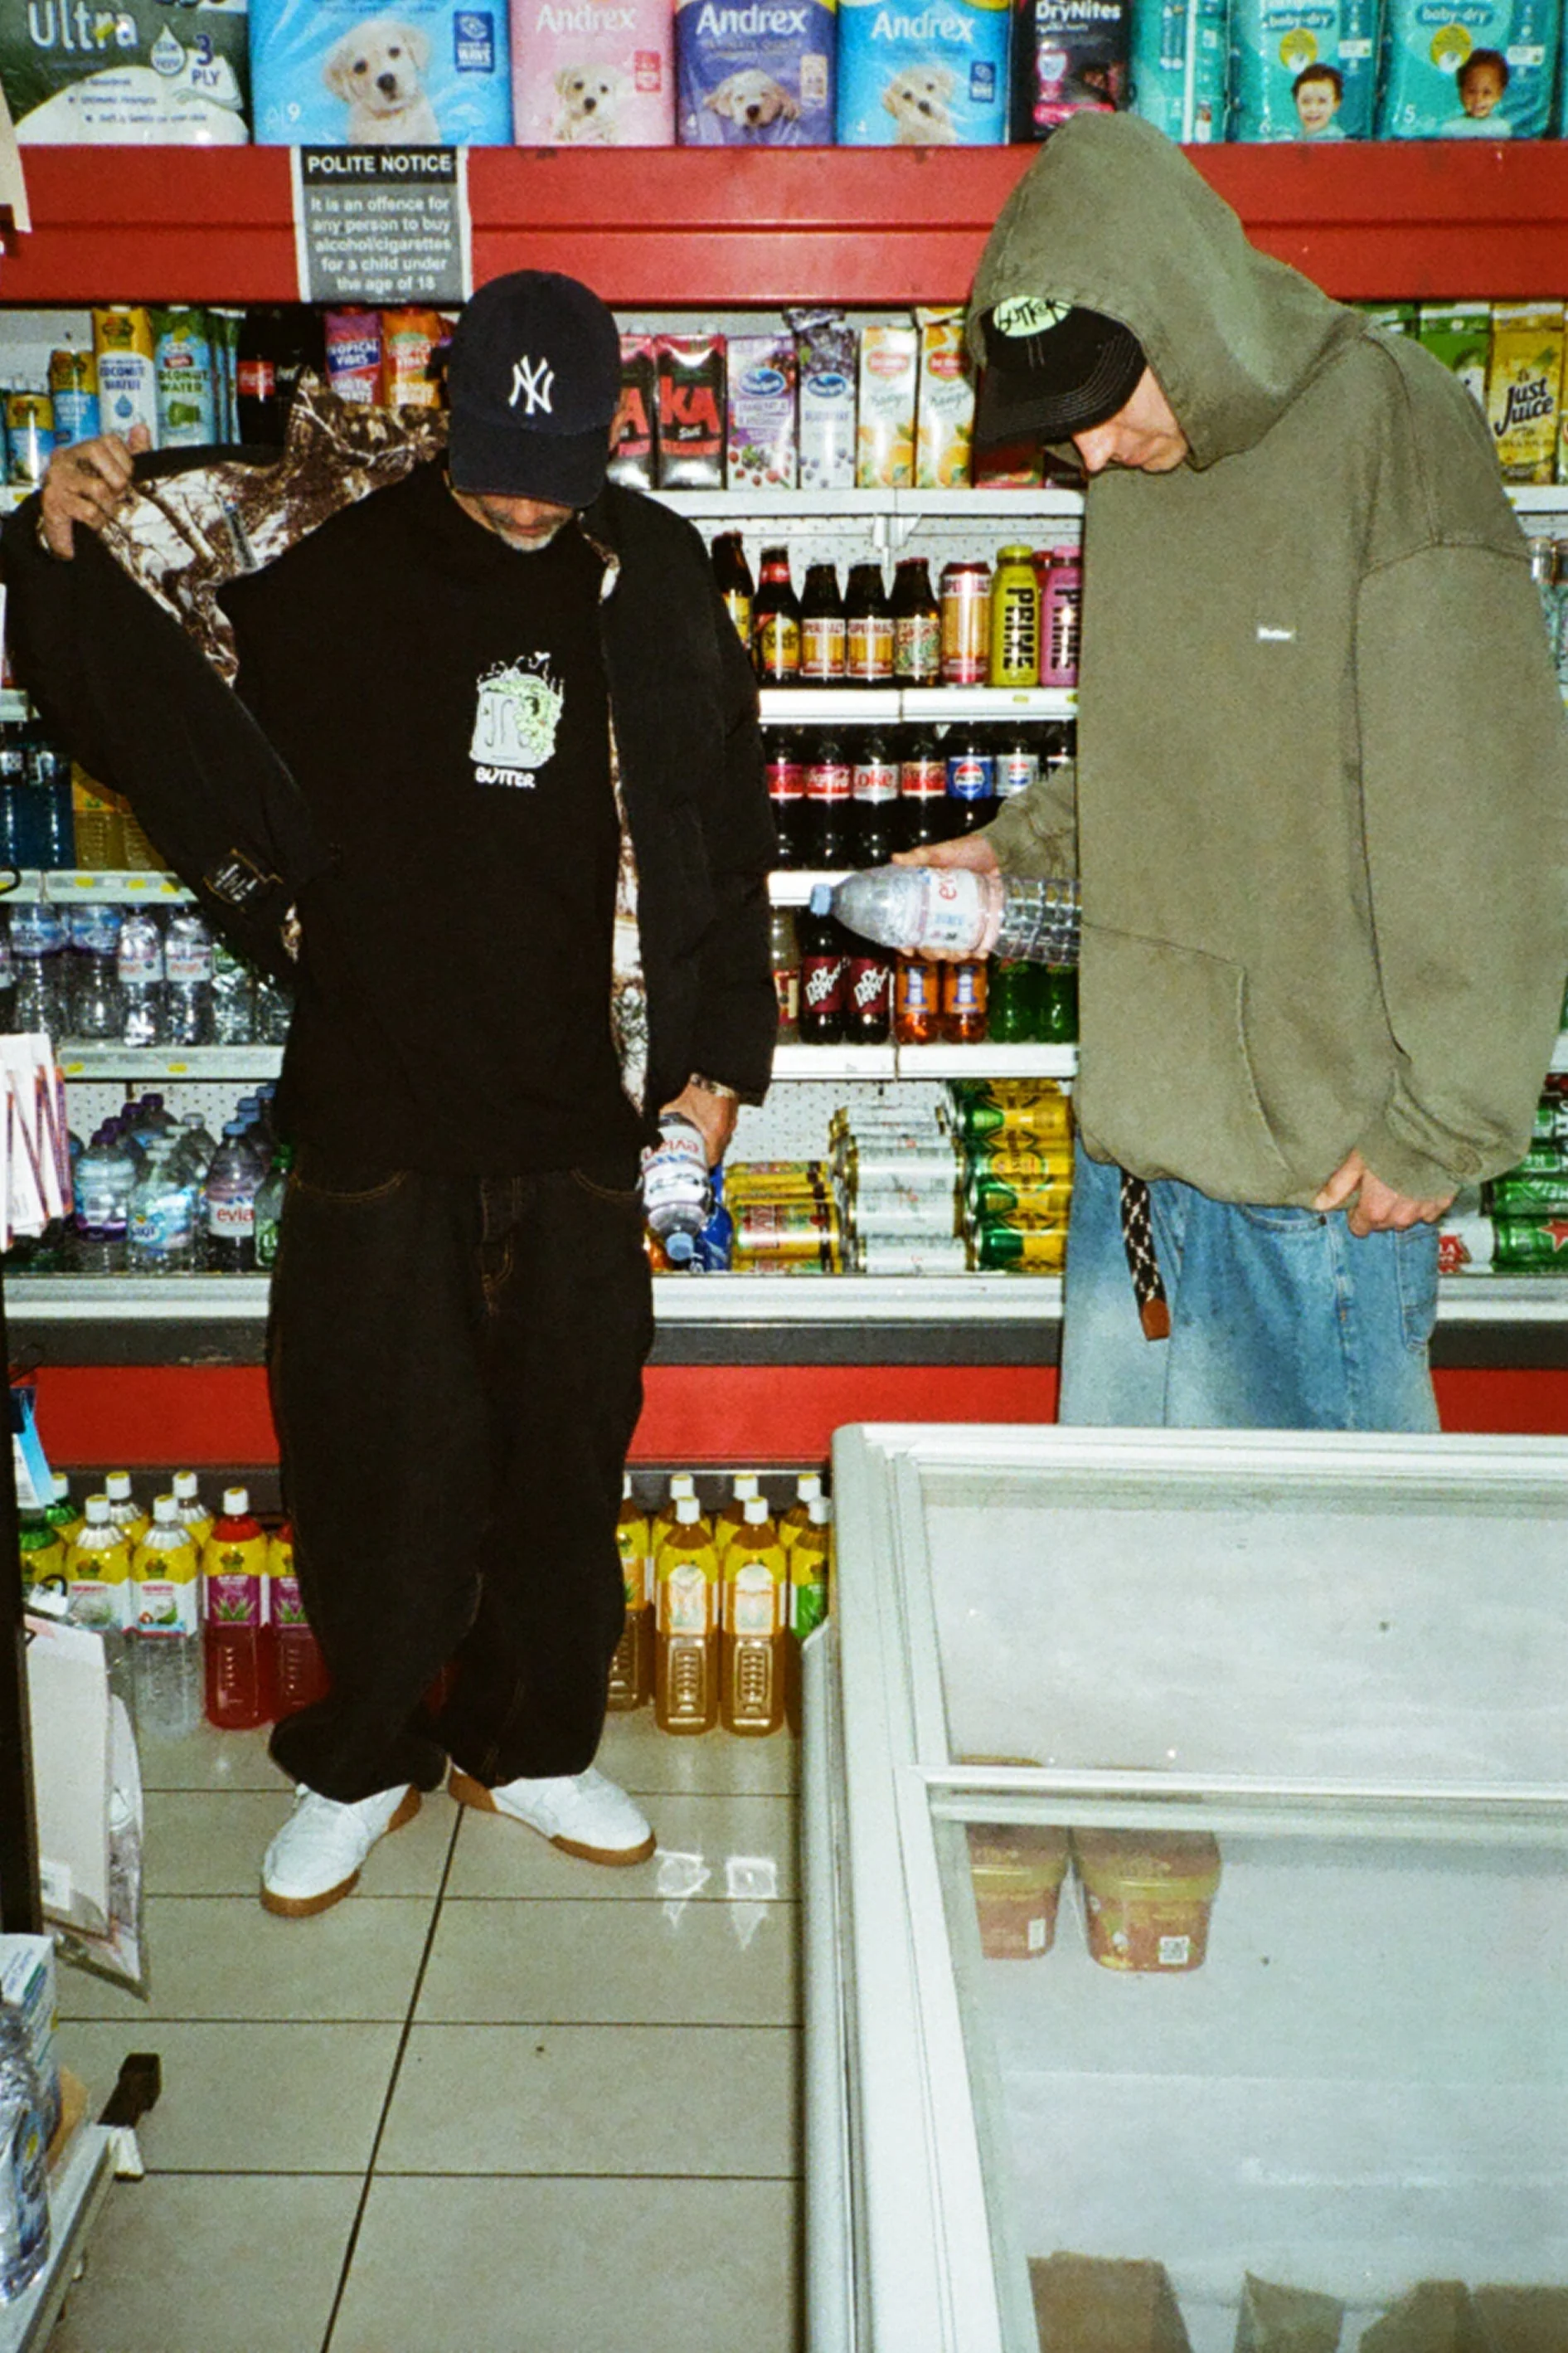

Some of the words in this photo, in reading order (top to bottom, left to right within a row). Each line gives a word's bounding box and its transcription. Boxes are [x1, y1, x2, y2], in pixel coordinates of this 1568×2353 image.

[536, 4, 638, 35] Andrex
[695, 3, 808, 36] Andrex
[1036, 1, 1121, 21] DryNites
[28, 0, 139, 50] Ultra
[871, 11, 975, 42] Andrex
[195, 34, 213, 66] 3
[192, 69, 221, 85] PLY
[287, 102, 301, 121] 9
[1403, 104, 1416, 124] 5
[308, 155, 376, 173] POLITE
[381, 154, 452, 173] NOTICE
[310, 197, 322, 211] It
[325, 198, 340, 211] is
[343, 200, 362, 211] an
[367, 196, 424, 211] offence
[428, 196, 449, 211] for
[313, 220, 341, 236] any
[344, 219, 399, 236] person
[403, 218, 420, 231] to
[422, 216, 451, 236] buy
[320, 257, 344, 271] for
[347, 260, 357, 271] a
[361, 256, 398, 271] child
[402, 257, 448, 271] under
[337, 276, 362, 290] the
[365, 279, 393, 294] age
[397, 275, 413, 290] of
[417, 275, 436, 290] 18
[508, 355, 555, 414] NY
[659, 376, 721, 434] KA
[216, 1208, 255, 1223] evia
